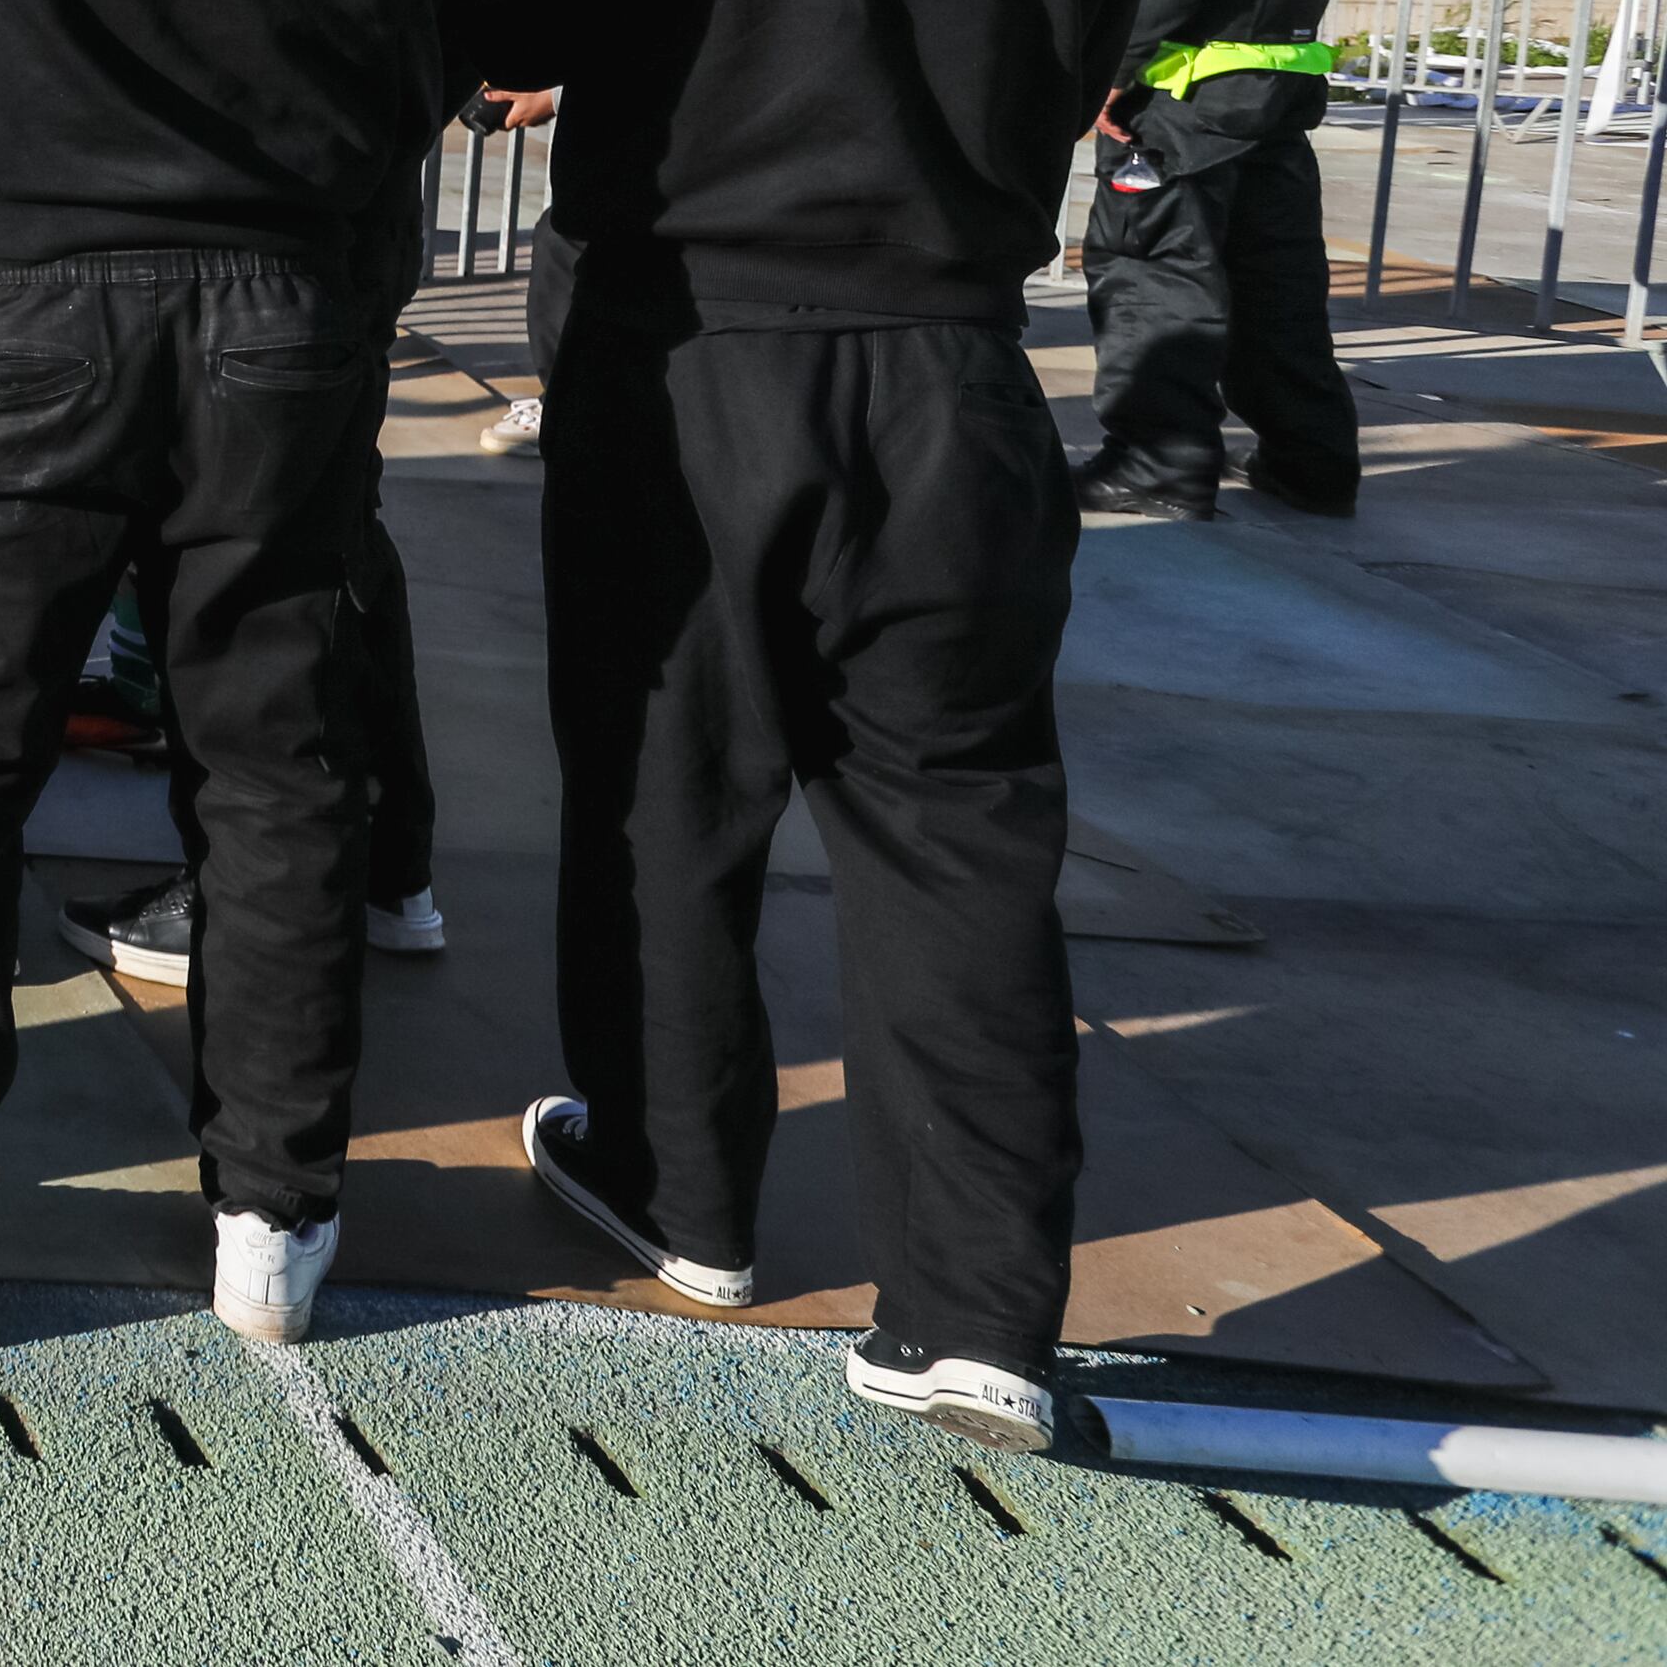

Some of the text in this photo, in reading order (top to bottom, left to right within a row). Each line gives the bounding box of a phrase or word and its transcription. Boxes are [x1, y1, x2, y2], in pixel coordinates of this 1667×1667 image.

[716, 1285, 731, 1301] ALL
[981, 1383, 1043, 1422] ALL STAR
